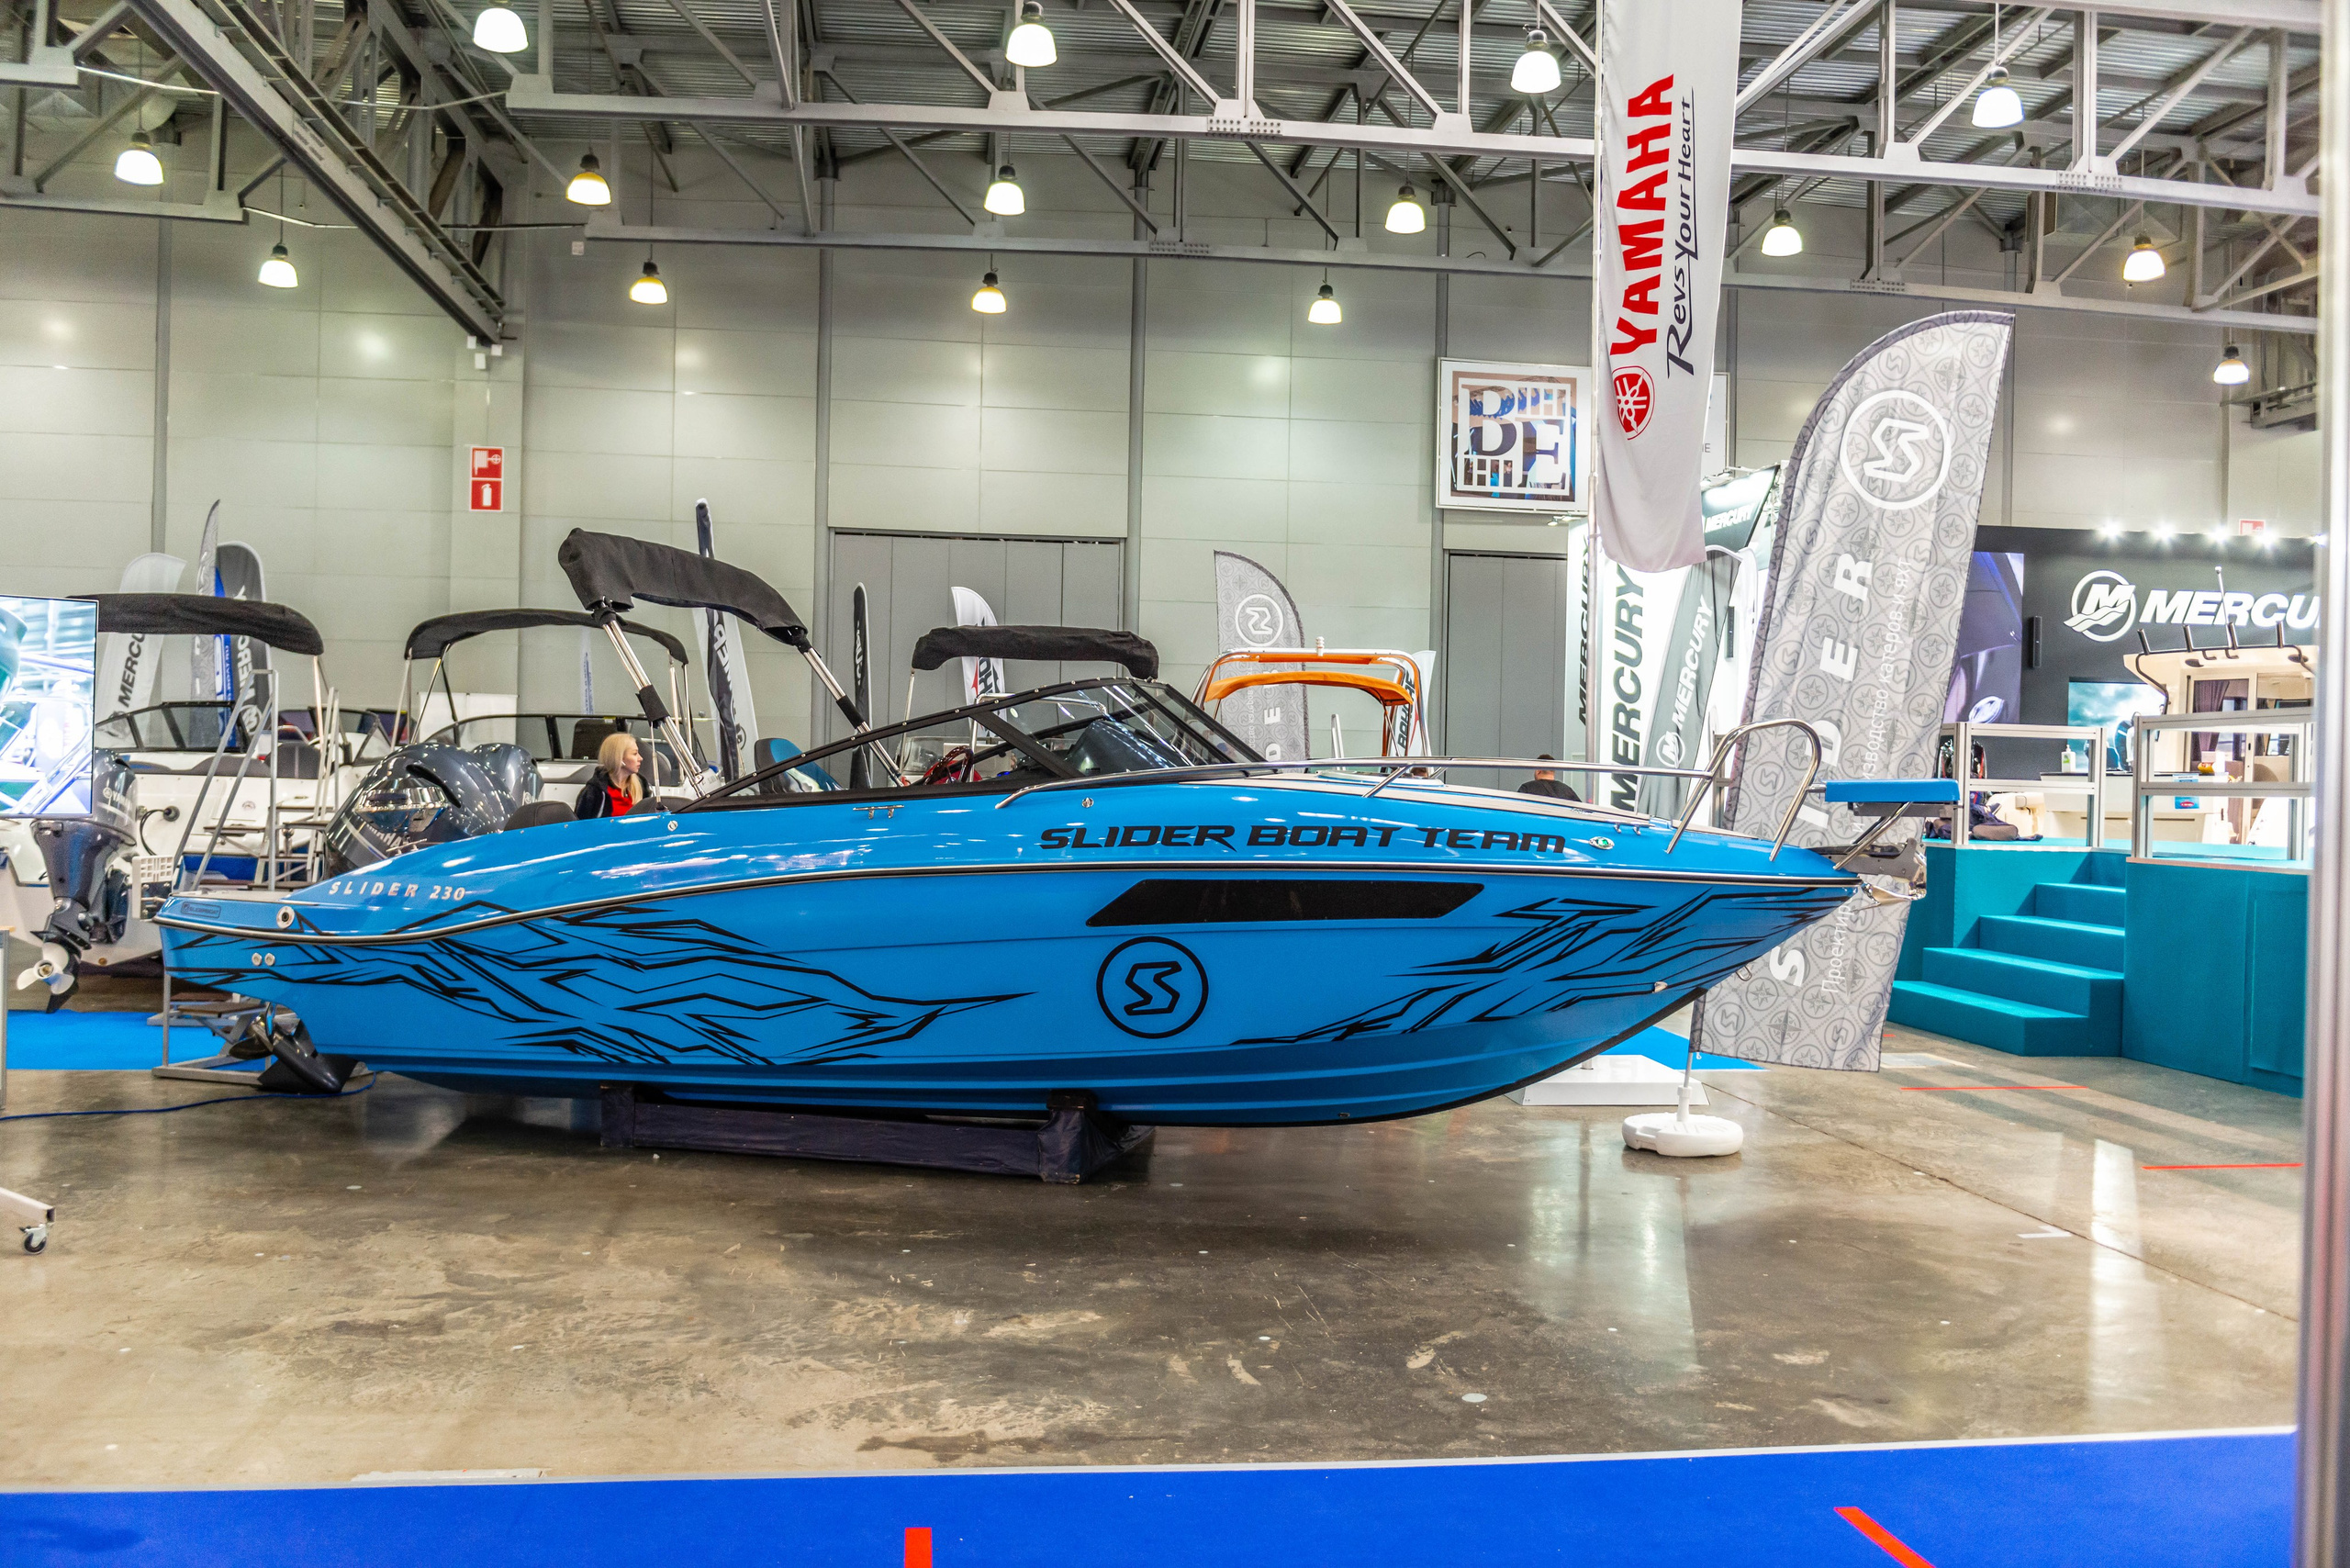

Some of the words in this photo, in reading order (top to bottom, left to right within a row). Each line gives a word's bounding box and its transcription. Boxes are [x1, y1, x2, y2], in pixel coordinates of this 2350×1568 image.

[1678, 95, 1693, 182] Heart
[1610, 73, 1673, 355] YAMAHA
[1674, 183, 1699, 262] Your
[1667, 264, 1695, 378] Revs
[1879, 615, 1904, 683] катеров
[2138, 588, 2321, 630] MERCU
[1610, 563, 1644, 812] MERCURY
[1672, 595, 1714, 732] MERCURY
[1039, 824, 1237, 852] SLIDER
[1247, 824, 1403, 847] BOAT
[1416, 827, 1566, 854] TEAM
[329, 880, 419, 898] SLIDER
[429, 884, 466, 901] 230
